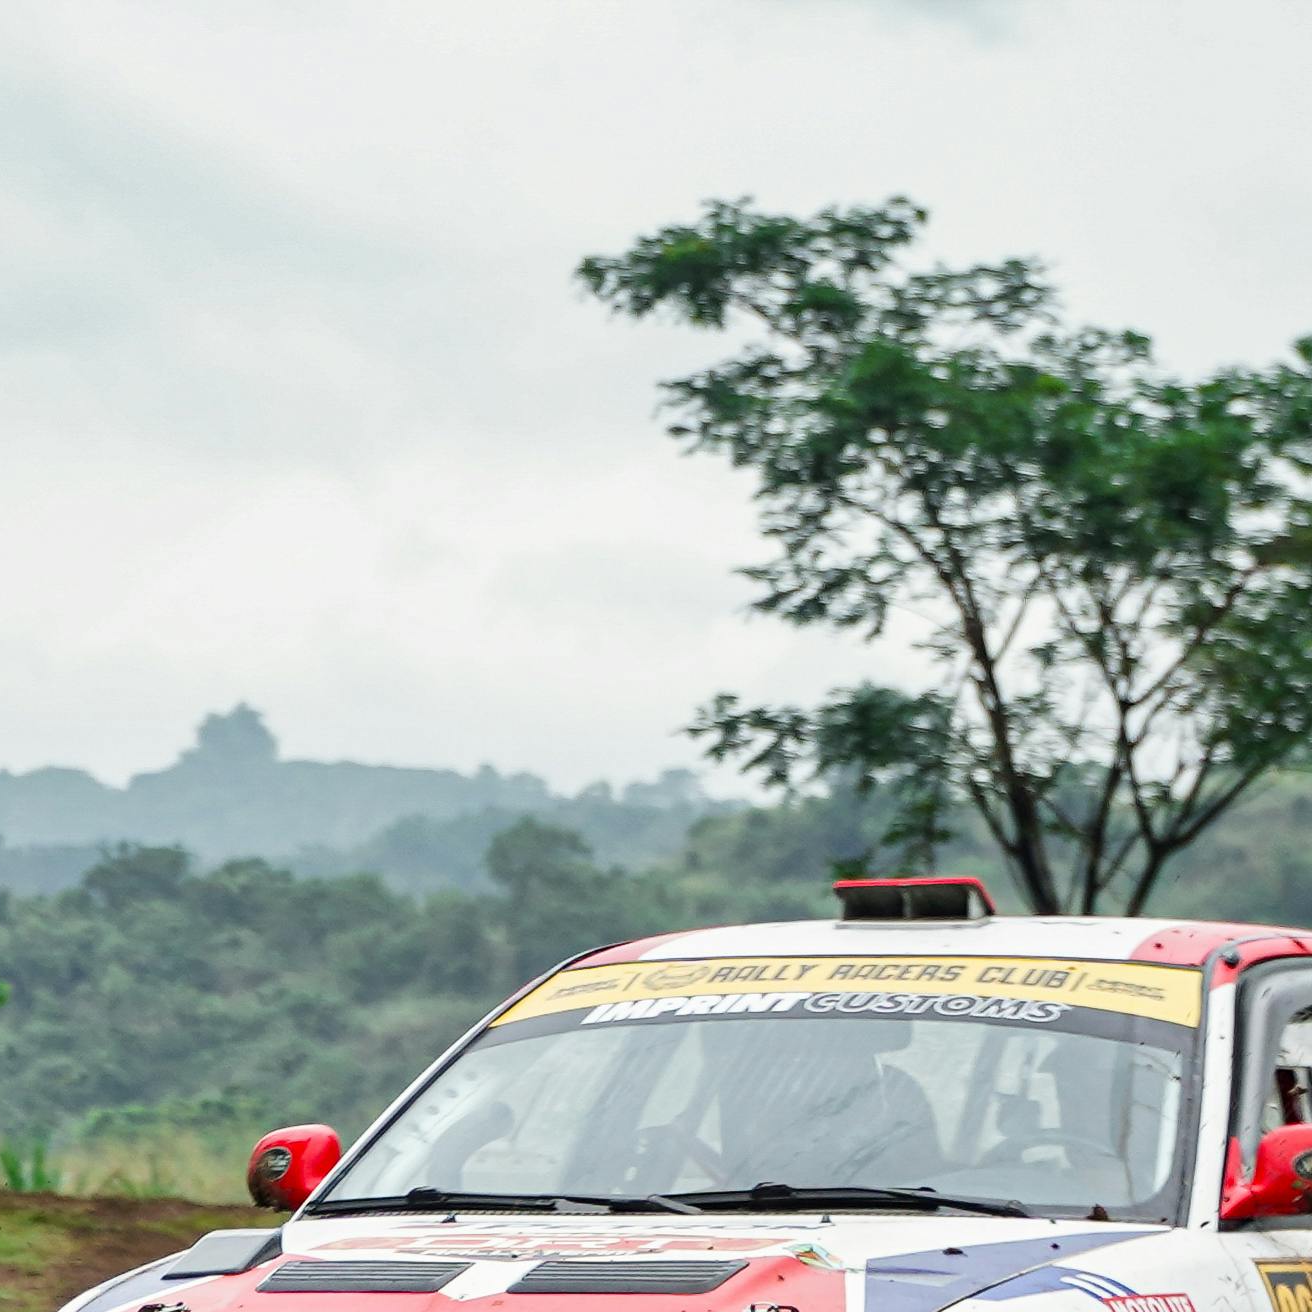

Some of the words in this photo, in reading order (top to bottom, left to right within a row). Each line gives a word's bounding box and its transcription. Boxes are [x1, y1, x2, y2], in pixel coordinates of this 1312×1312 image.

[708, 963, 818, 985] RALLY
[827, 963, 966, 983] RACERS
[975, 966, 1073, 990] CLUB
